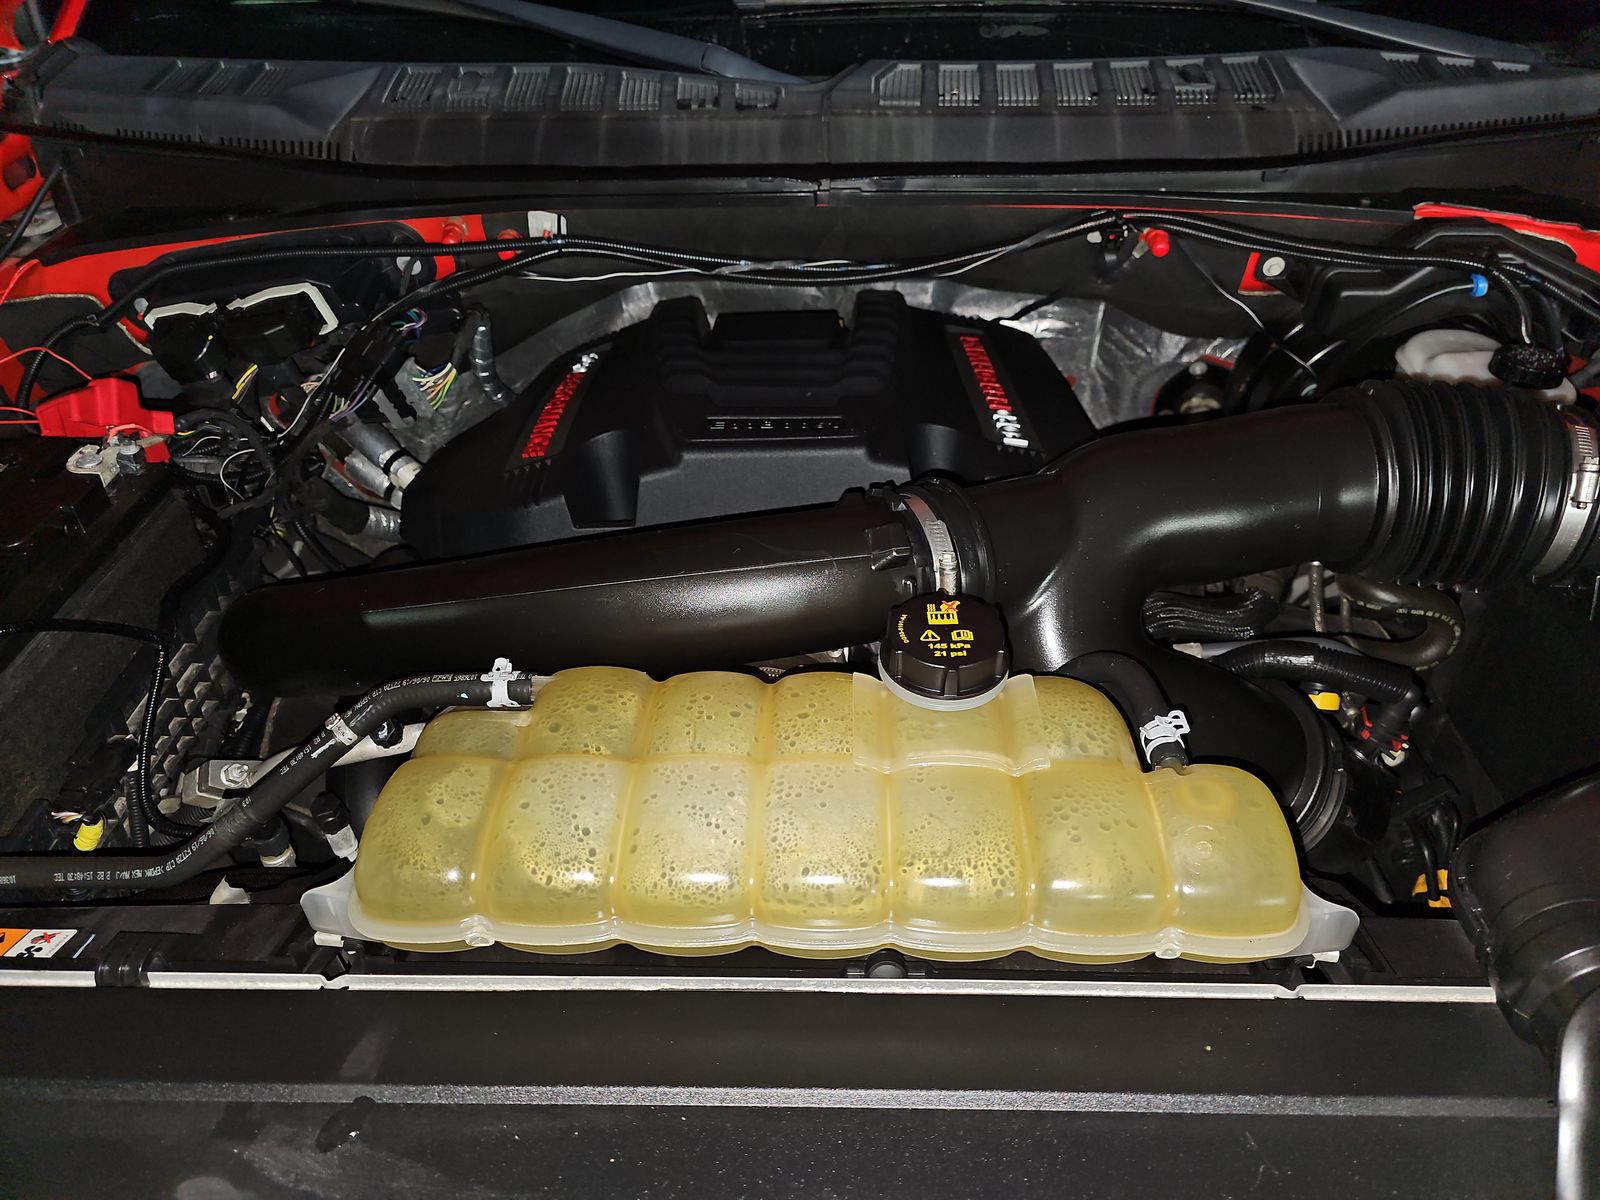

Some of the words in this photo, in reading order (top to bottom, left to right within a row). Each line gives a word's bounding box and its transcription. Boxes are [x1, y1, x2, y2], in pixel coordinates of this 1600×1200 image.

[927, 642, 948, 650] 145
[949, 642, 971, 650] kPa
[950, 650, 967, 658] psi
